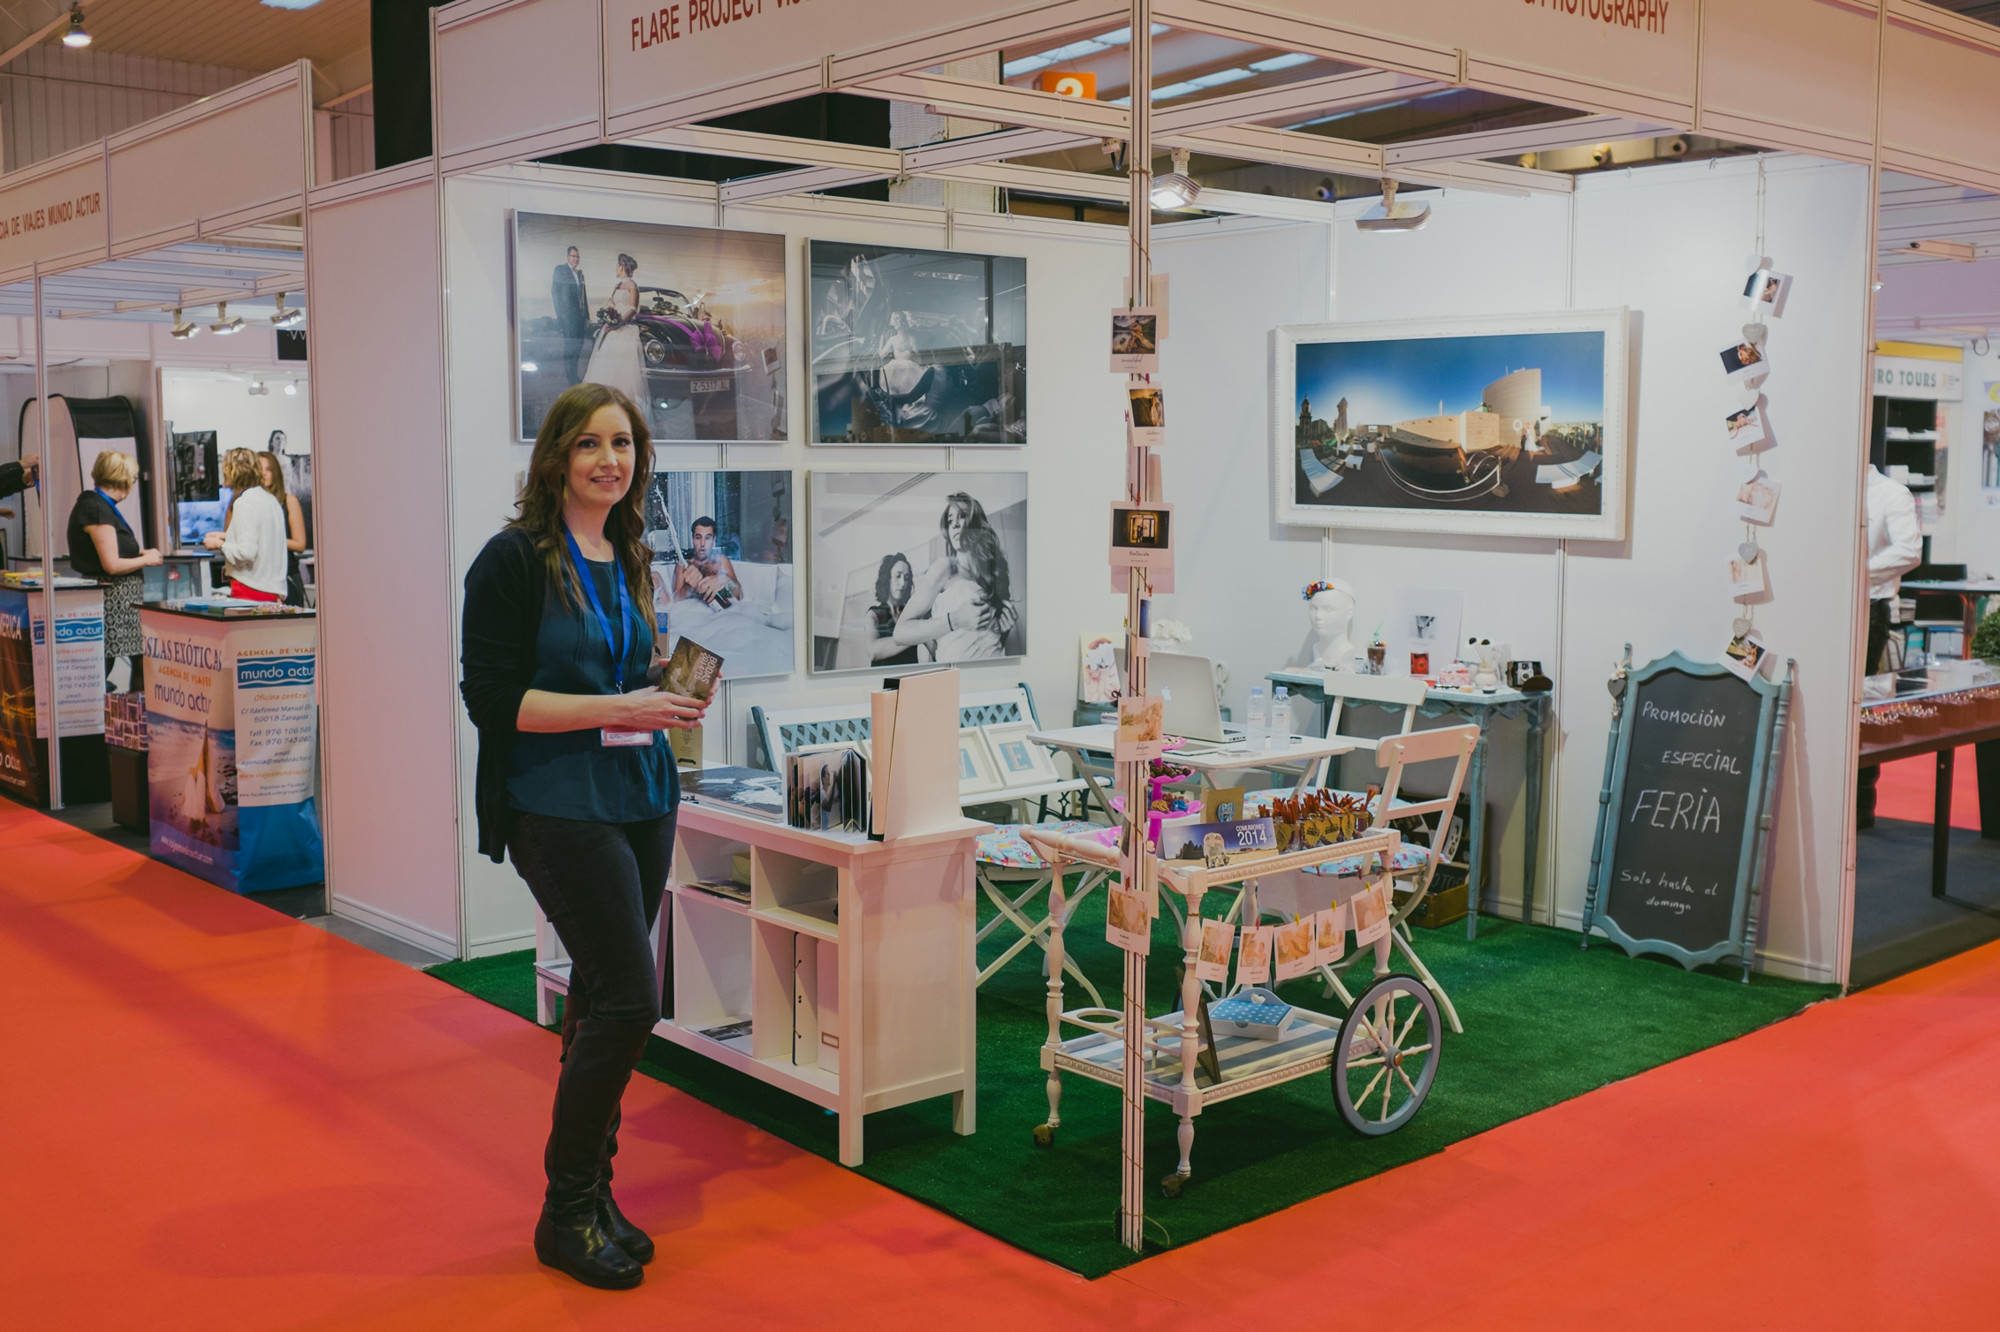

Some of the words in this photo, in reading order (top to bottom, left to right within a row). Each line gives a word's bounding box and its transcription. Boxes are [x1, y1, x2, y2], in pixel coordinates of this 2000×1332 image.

[632, 5, 681, 51] FLARE
[1540, 0, 1669, 35] OGRAPHY
[22, 209, 45, 232] VIAJES
[48, 201, 73, 226] MUNDO
[76, 192, 101, 218] ACTUR
[1873, 368, 1894, 385] RO
[1900, 370, 1937, 388] TOURS
[76, 626, 102, 636] actur
[241, 665, 284, 680] mundo
[288, 665, 315, 677] actu
[702, 656, 718, 685] BODAS
[154, 682, 186, 708] mundo
[1630, 787, 1721, 834] FERIA
[1235, 823, 1265, 832] COMUNIONES
[1237, 830, 1267, 846] 2014
[1621, 869, 1651, 884] Solo
[1658, 872, 1694, 893] hasta
[1704, 882, 1718, 896] el
[1646, 896, 1692, 915] domingo
